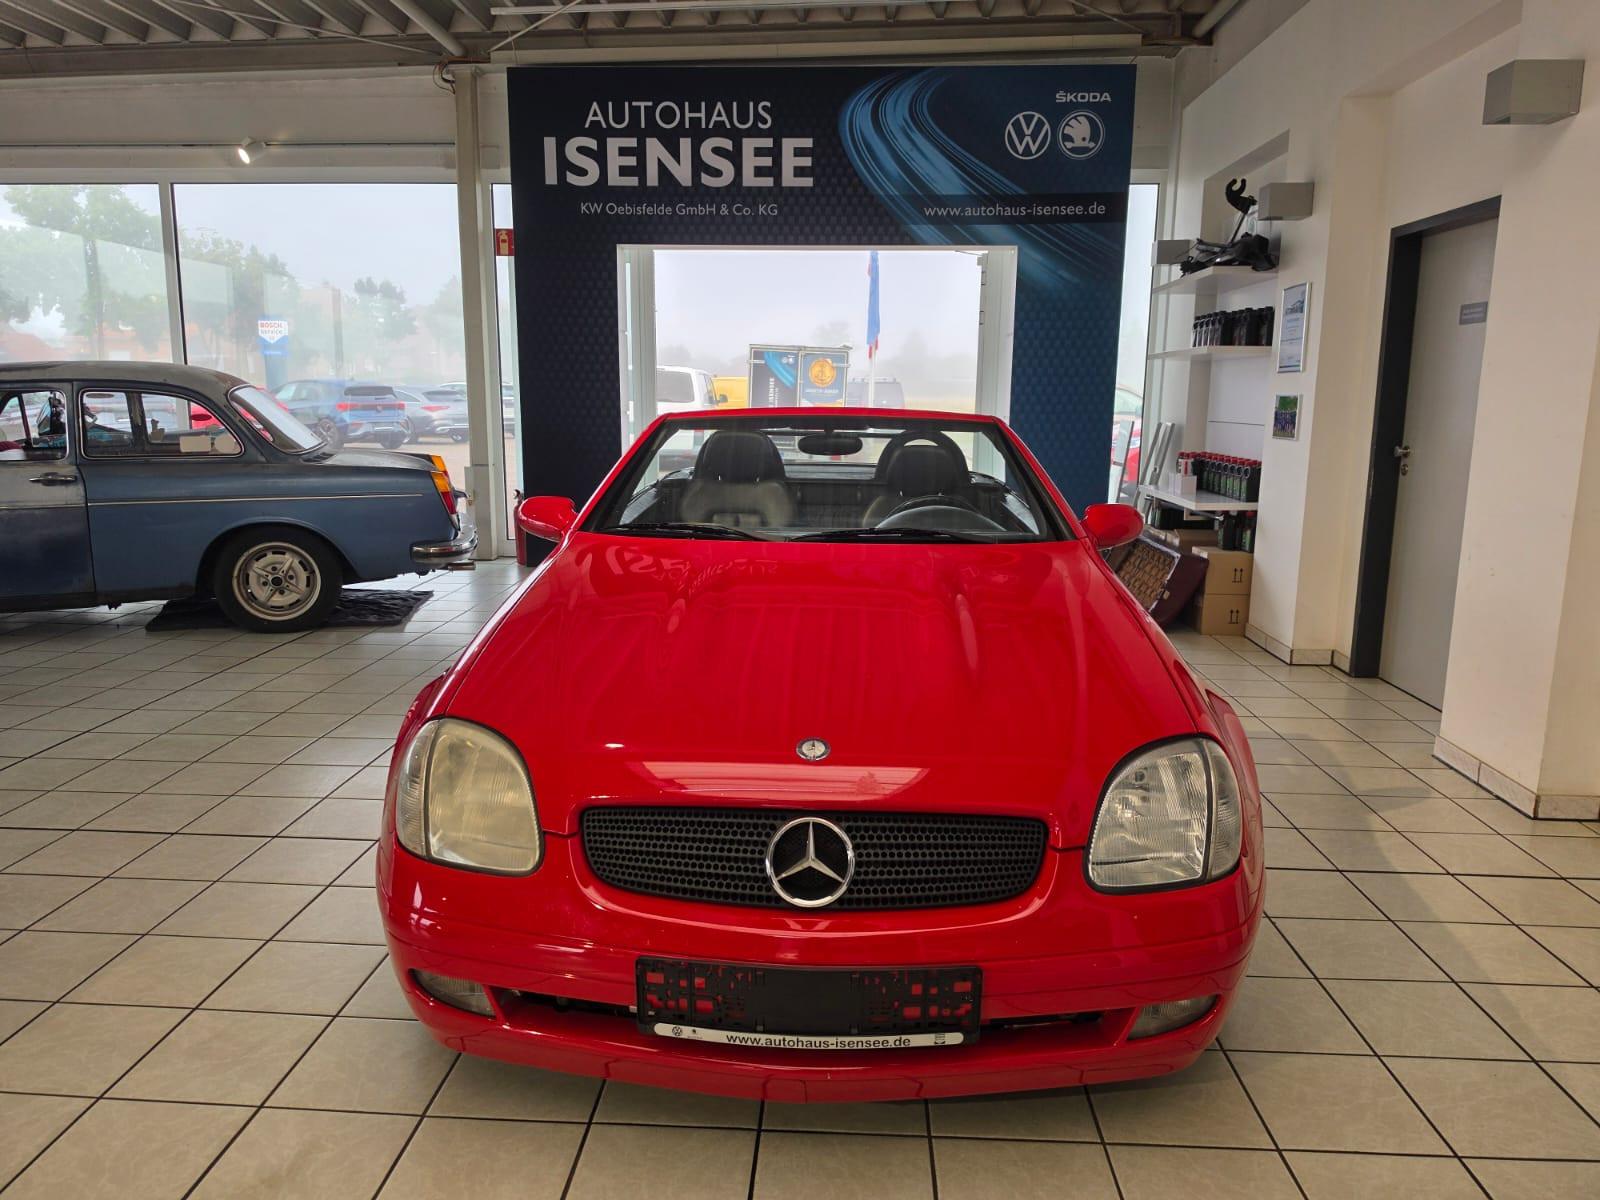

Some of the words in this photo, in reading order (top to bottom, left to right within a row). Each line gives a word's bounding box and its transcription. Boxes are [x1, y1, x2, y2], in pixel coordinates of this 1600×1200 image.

[1055, 91, 1112, 103] ŠKODA
[584, 101, 773, 129] AUTOHAUS
[543, 136, 815, 187] ISENSEE
[580, 202, 603, 215] KW
[605, 202, 673, 216] Oebisfelde
[675, 203, 717, 216] GmbH
[719, 203, 730, 216] &
[732, 203, 755, 216] Co.
[758, 203, 779, 216] KG
[923, 201, 1107, 217] www.autohaus-isensee.de
[726, 1031, 911, 1049] www.autohaus-isensee.de
